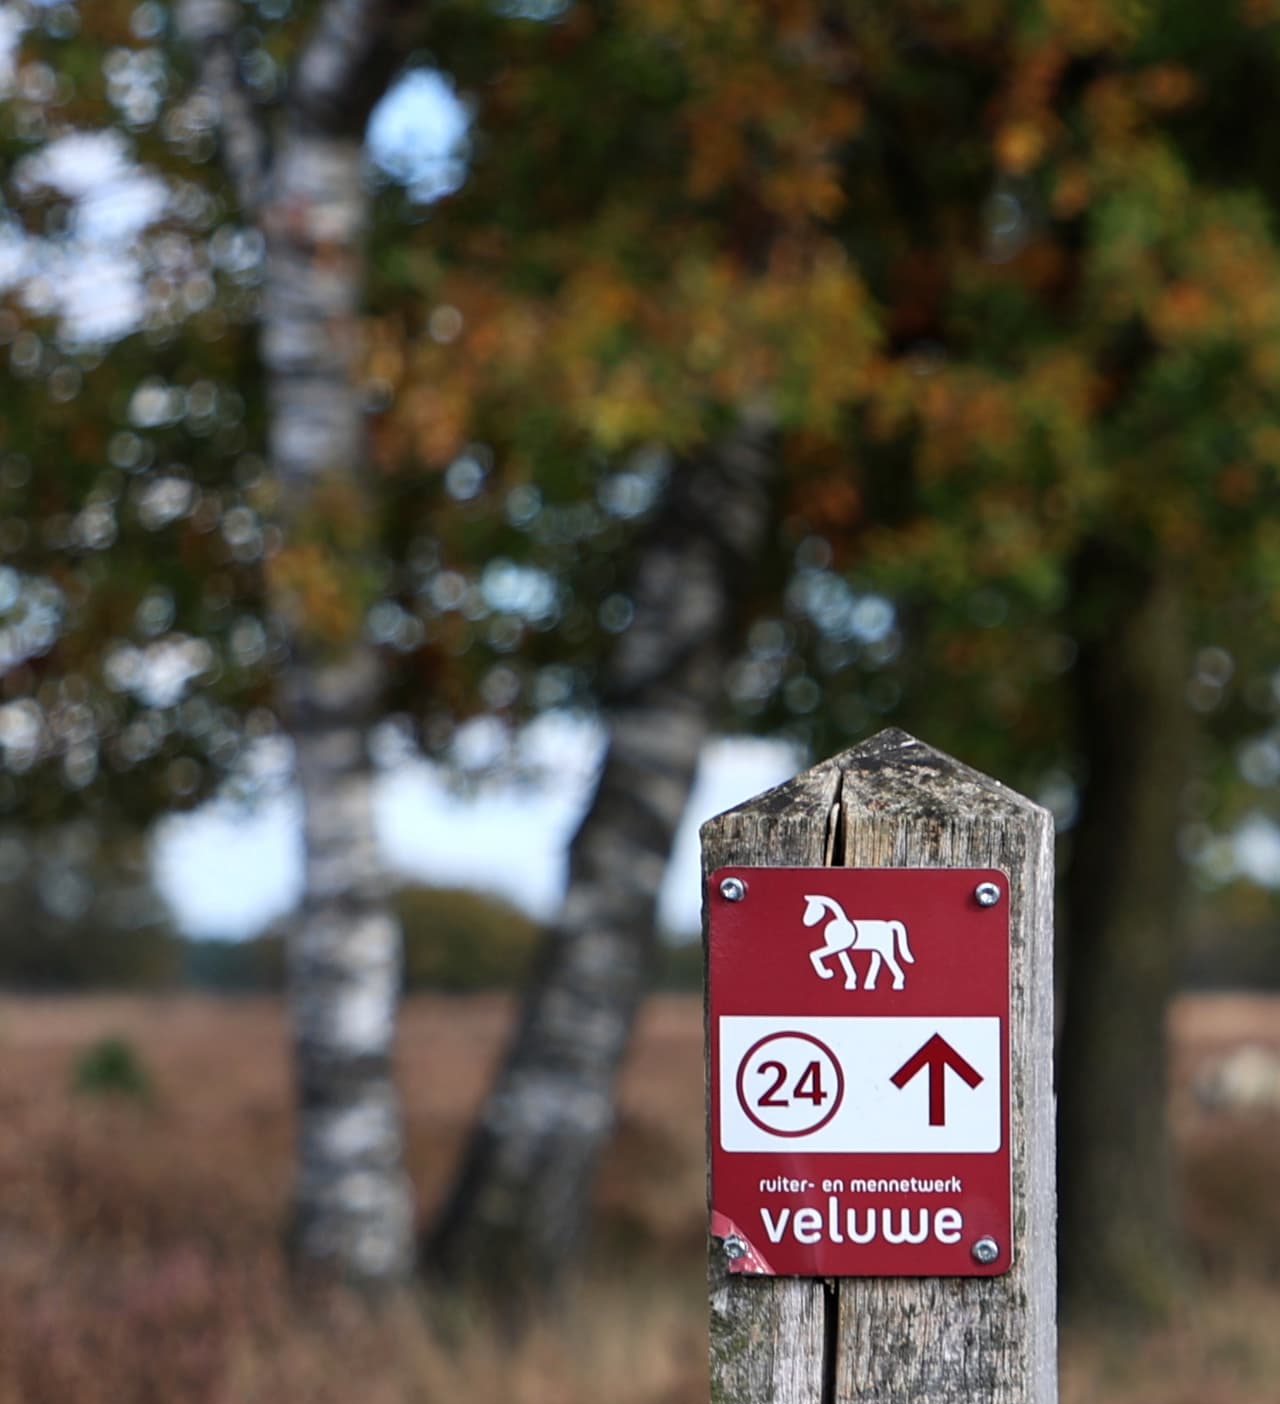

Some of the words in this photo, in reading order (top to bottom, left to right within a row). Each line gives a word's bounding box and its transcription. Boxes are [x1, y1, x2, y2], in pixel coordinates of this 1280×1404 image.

[756, 1060, 828, 1107] 24
[759, 1176, 815, 1192] ruiter-
[822, 1179, 844, 1192] en
[850, 1176, 962, 1192] mennetwerk
[760, 1196, 963, 1244] veluwe
